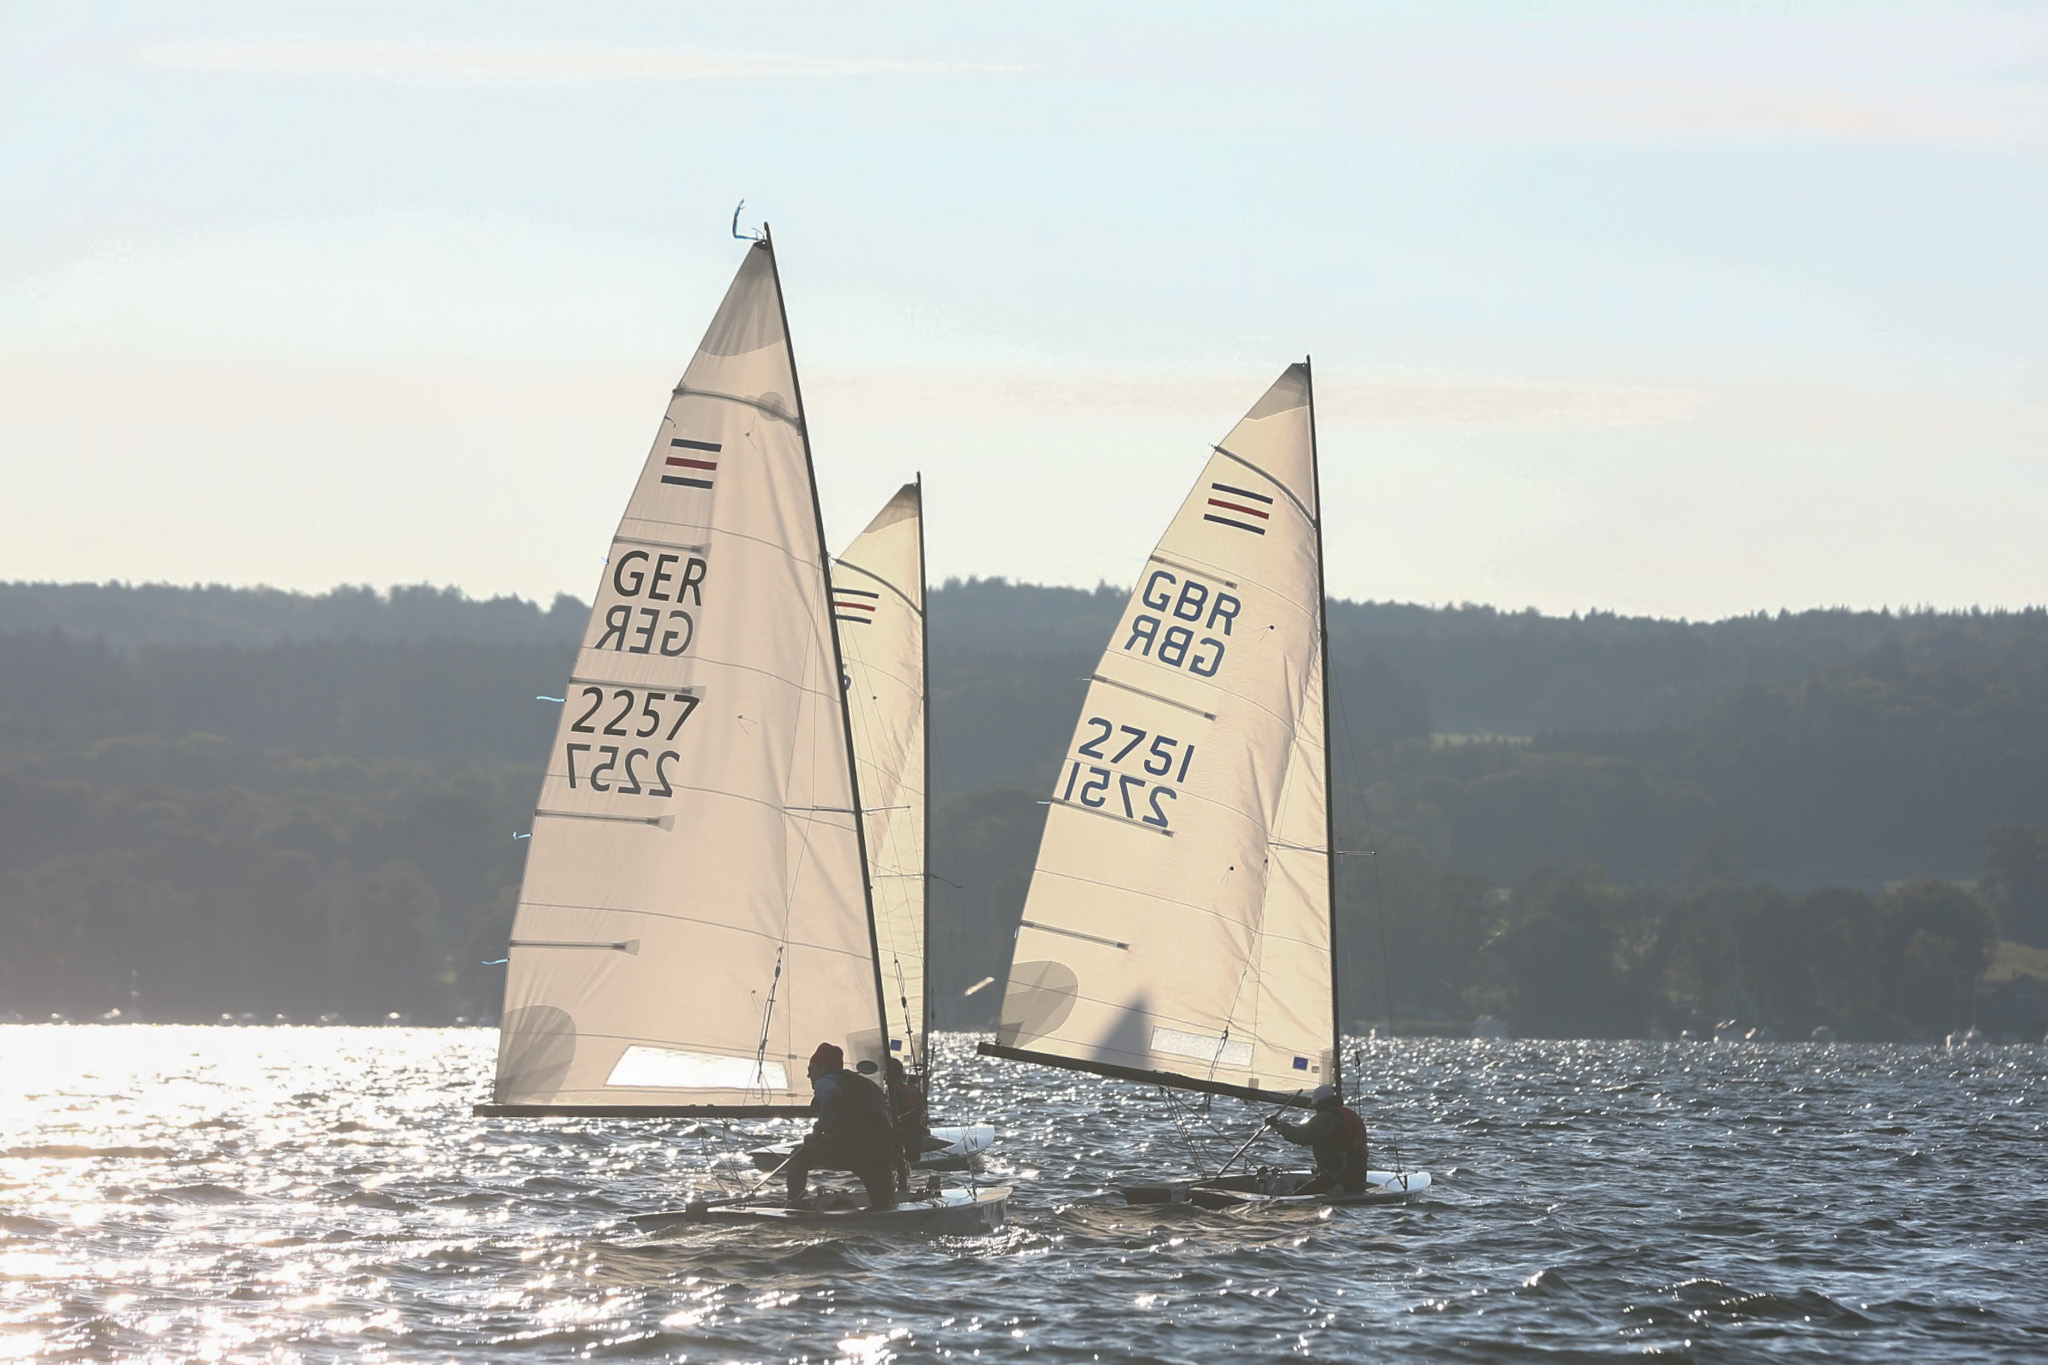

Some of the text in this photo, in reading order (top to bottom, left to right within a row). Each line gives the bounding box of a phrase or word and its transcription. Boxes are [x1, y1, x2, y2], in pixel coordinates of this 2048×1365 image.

[613, 550, 707, 606] GER
[1142, 570, 1241, 636] GBR
[571, 686, 700, 741] 2257
[1078, 716, 1195, 783] 2751
